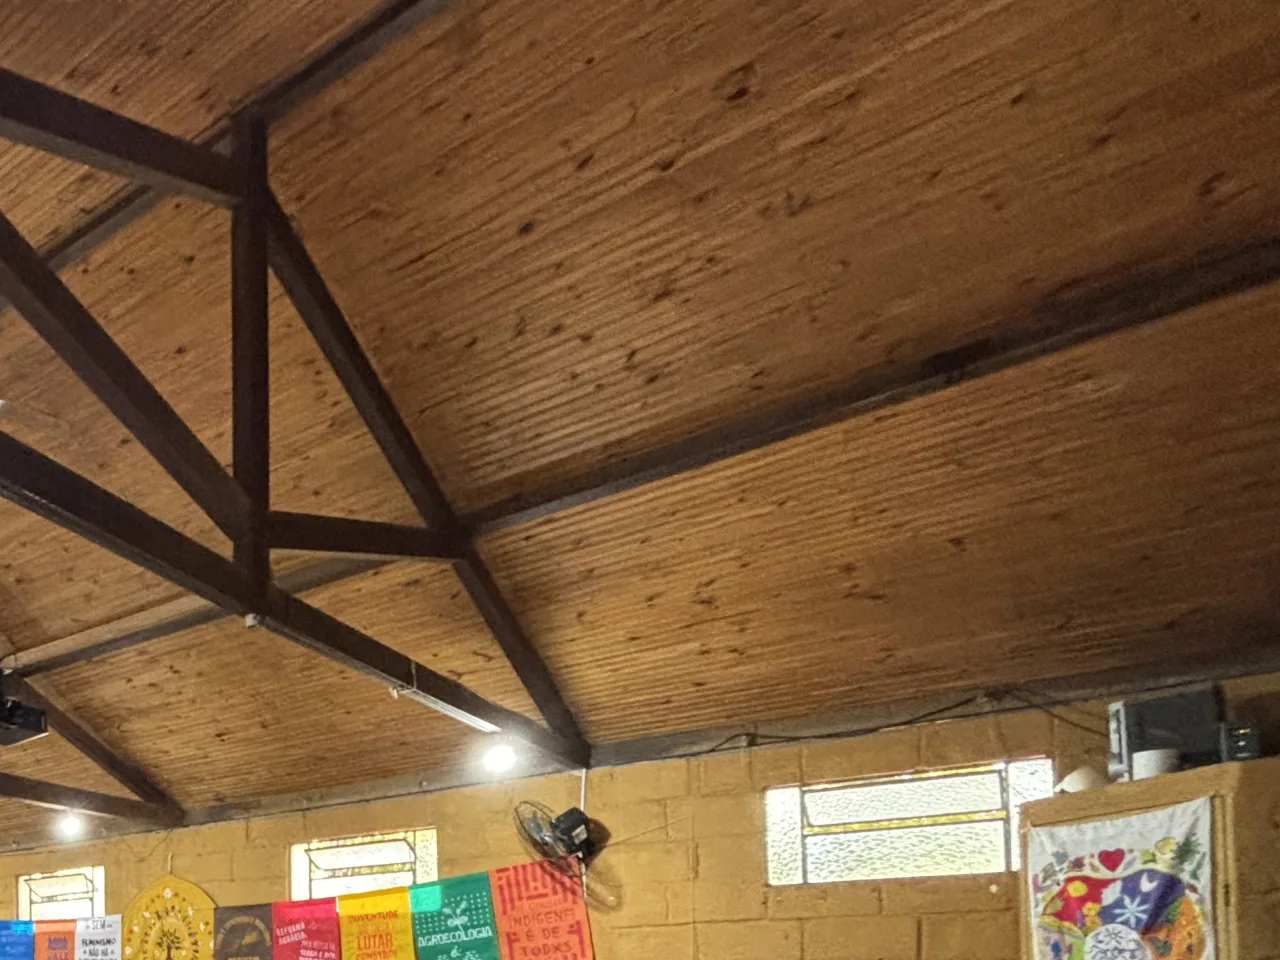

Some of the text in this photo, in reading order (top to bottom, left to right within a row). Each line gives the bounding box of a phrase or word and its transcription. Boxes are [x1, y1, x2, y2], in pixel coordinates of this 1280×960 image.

[355, 932, 394, 951] LUTAR
[418, 926, 493, 947] AGROECOLOGIA
[542, 926, 560, 940] DE
[81, 937, 117, 948] FEMINISMO
[519, 939, 573, 957] TODXS
